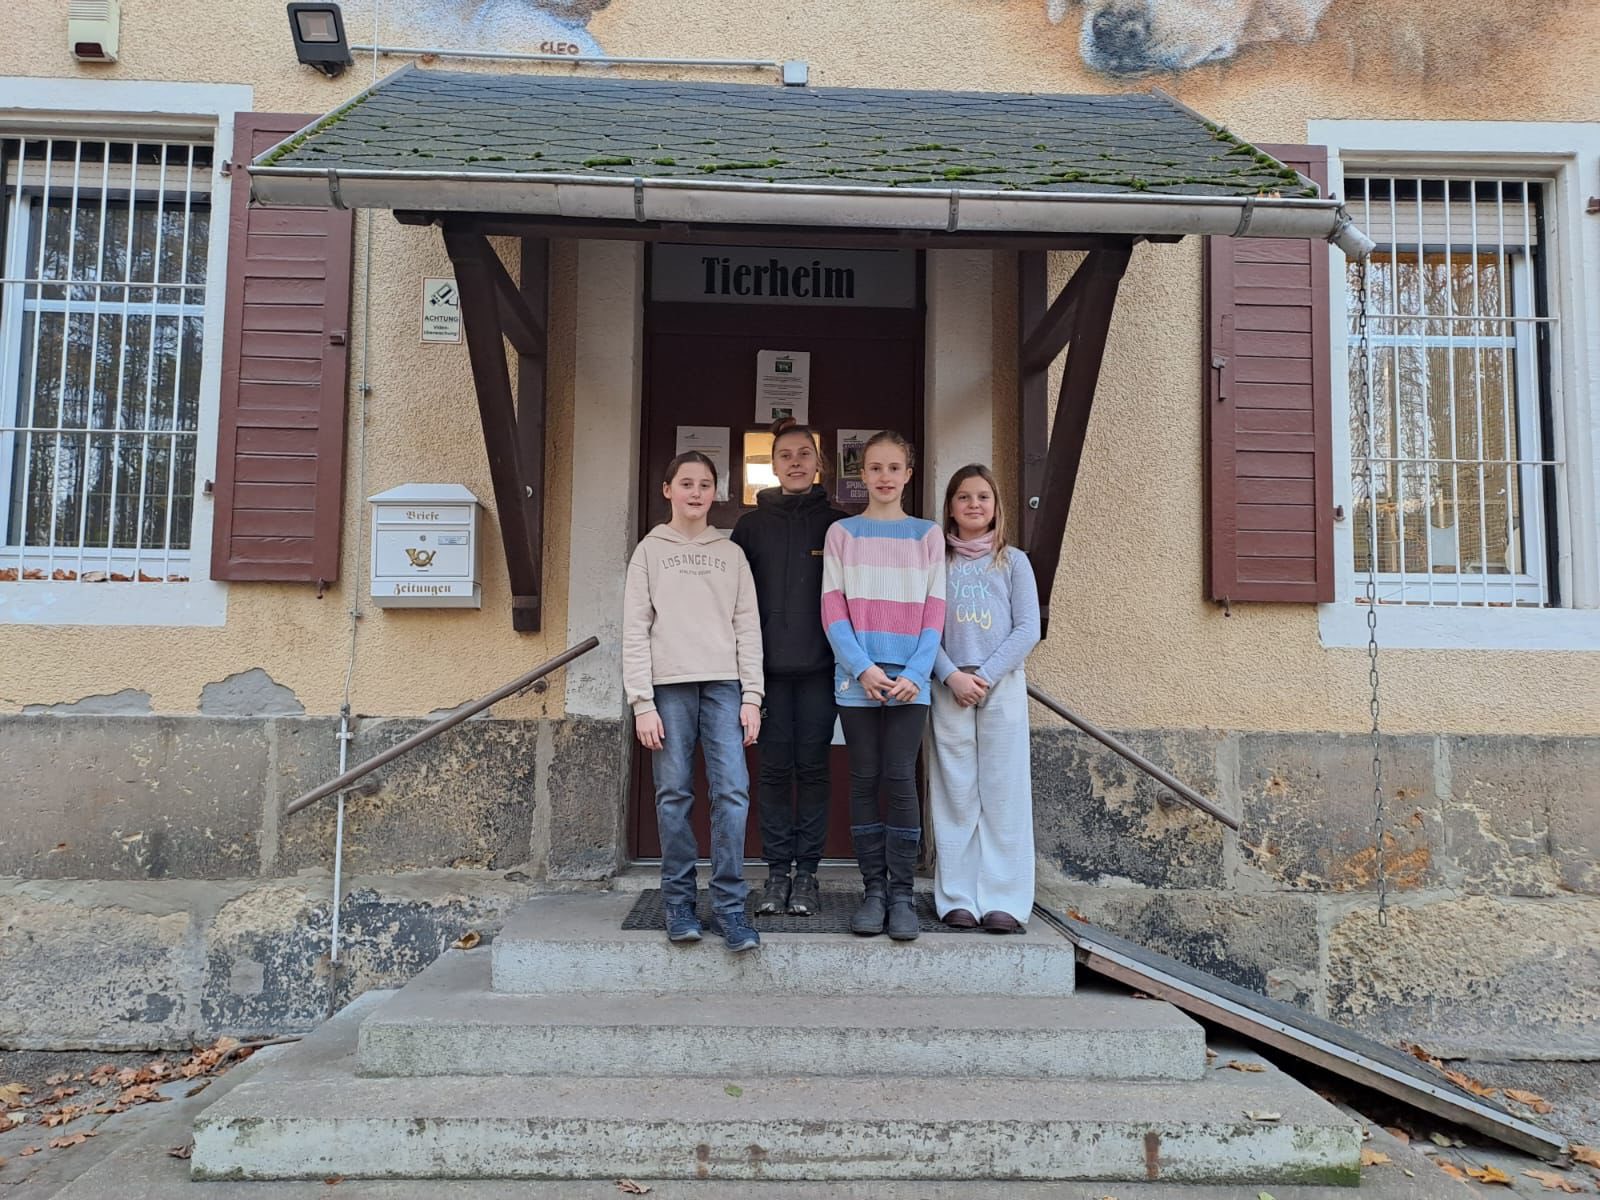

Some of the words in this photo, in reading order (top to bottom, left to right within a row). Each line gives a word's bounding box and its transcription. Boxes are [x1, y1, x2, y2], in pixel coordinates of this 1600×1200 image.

[540, 41, 579, 55] CLEO
[702, 257, 855, 299] Tierheim
[406, 511, 440, 520] Briefe
[661, 555, 680, 569] LOS
[682, 554, 727, 572] ANGELES
[393, 583, 451, 595] Zeitungen
[951, 580, 992, 600] York
